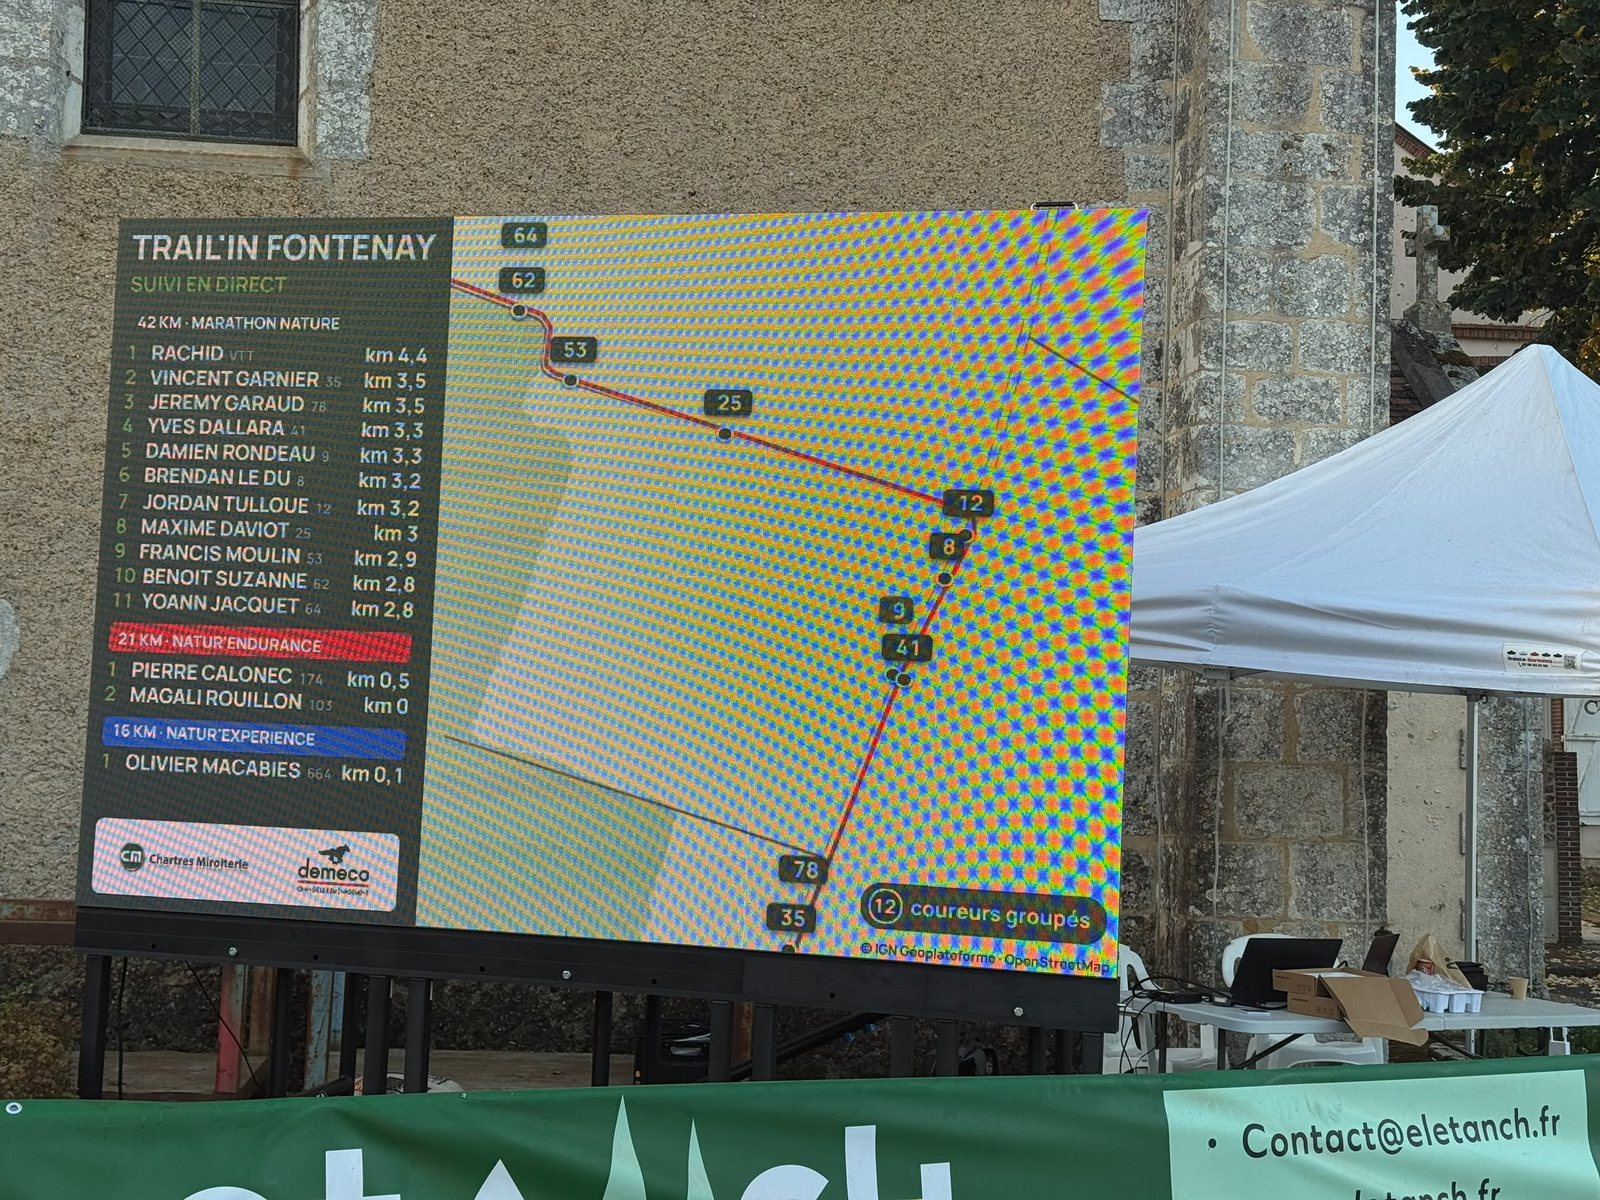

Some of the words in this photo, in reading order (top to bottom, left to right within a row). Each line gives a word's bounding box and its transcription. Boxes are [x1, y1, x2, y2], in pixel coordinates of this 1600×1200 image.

[514, 228, 537, 243] 64
[132, 234, 258, 261] TRAIL'IN
[267, 233, 437, 261] FONTENAY
[131, 277, 182, 292] SUIVI
[187, 277, 211, 292] EN
[216, 277, 287, 293] DIRECT
[512, 273, 535, 287] 62
[138, 316, 156, 328] 42
[159, 316, 181, 328] KM
[192, 317, 276, 330] MARATHON
[280, 318, 340, 330] NATURE
[129, 346, 136, 360] 1
[152, 346, 224, 361] RACHID
[229, 351, 254, 362] VTT
[366, 348, 393, 362] km
[397, 348, 428, 366] 4,4
[564, 342, 587, 357] 53
[126, 371, 136, 385] 2
[151, 371, 232, 387] VINCENT
[236, 371, 319, 388] GARNIER
[364, 373, 392, 388] km
[397, 373, 426, 391] 3,5
[124, 395, 134, 409] 3
[148, 394, 221, 410] JEREMY
[225, 395, 304, 412] GARAUD
[311, 402, 327, 412] 78
[362, 398, 391, 414] km
[396, 398, 425, 416] 3,5
[717, 395, 742, 410] 25
[122, 418, 132, 433] 4
[148, 418, 195, 434] YVES
[199, 419, 285, 436] DALLARA
[361, 422, 389, 438] km
[394, 423, 424, 441] 3,3
[121, 443, 131, 458] 5
[146, 443, 218, 459] DAMIEN
[222, 444, 315, 461] RONDEAU
[322, 451, 329, 462] 9
[359, 448, 388, 464] km
[392, 448, 422, 466] 3,3
[119, 468, 130, 482] 6
[144, 467, 234, 484] BRENDAN
[238, 469, 258, 484] LE
[263, 469, 291, 485] DU
[297, 476, 304, 487] 8
[358, 472, 387, 488] km
[392, 472, 421, 491] 3,2
[118, 494, 128, 509] 7
[142, 495, 219, 512] JORDAN
[223, 496, 309, 514] TULLOUE
[316, 504, 331, 514] 12
[357, 500, 385, 516] km
[390, 501, 419, 520] 3,2
[959, 495, 983, 511] 12
[116, 518, 127, 533] 8
[141, 519, 216, 537] MAXIME
[220, 521, 289, 539] DAVIOT
[296, 528, 311, 539] 25
[374, 524, 401, 541] km
[407, 526, 418, 542] 3
[114, 543, 126, 558] 9
[139, 544, 221, 562] FRANCIS
[226, 546, 301, 564] MOULIN
[306, 553, 322, 564] 53
[354, 551, 382, 567] km
[387, 551, 417, 570] 2,9
[944, 538, 955, 555] 8
[114, 568, 136, 583] 10
[143, 568, 212, 586] BENOIT
[216, 571, 307, 589] SUZANNE
[314, 578, 330, 589] 62
[352, 575, 381, 592] km
[385, 576, 415, 595] 2,8
[112, 592, 132, 608] 11
[142, 593, 208, 610] YOANN
[211, 596, 299, 615] JACQUET
[305, 603, 321, 615] 64
[351, 601, 379, 617] km
[384, 601, 414, 621] 2,8
[893, 602, 905, 619] 9
[118, 633, 136, 646] 21
[139, 634, 162, 647] KM
[172, 635, 322, 653] NATUR'ENDURANCE
[896, 639, 919, 655] 41
[108, 661, 116, 676] 1
[131, 662, 198, 680] PIERRE
[201, 665, 292, 684] CALONEC
[299, 673, 323, 685] 174
[348, 671, 374, 688] km
[379, 672, 410, 692] 0,5
[105, 686, 116, 701] 2
[130, 687, 201, 705] MAGALI
[206, 689, 302, 709] ROUILLON
[309, 699, 332, 711] 103
[364, 697, 392, 714] km
[396, 698, 409, 714] 0
[113, 724, 130, 737] 16
[133, 724, 156, 738] KM
[166, 726, 315, 746] NATUR'EXPERIENCE
[102, 753, 109, 768] 1
[126, 754, 198, 773] OLIVIER
[202, 758, 300, 778] MACABIES
[307, 768, 331, 779] 664
[341, 765, 369, 782] km
[374, 766, 403, 786] 0,1
[150, 854, 194, 866] Chartres
[298, 858, 369, 881] demeco
[794, 861, 818, 879] 78
[781, 910, 805, 926] 35
[875, 898, 896, 914] 12
[911, 902, 1001, 922] coureurs
[1006, 906, 1090, 931] groupés
[876, 944, 898, 955] IGN
[900, 946, 995, 964] Géoplateforme
[1005, 954, 1111, 974] OpenStreetMap
[1241, 1105, 1562, 1159] Contact@eletanch.fr
